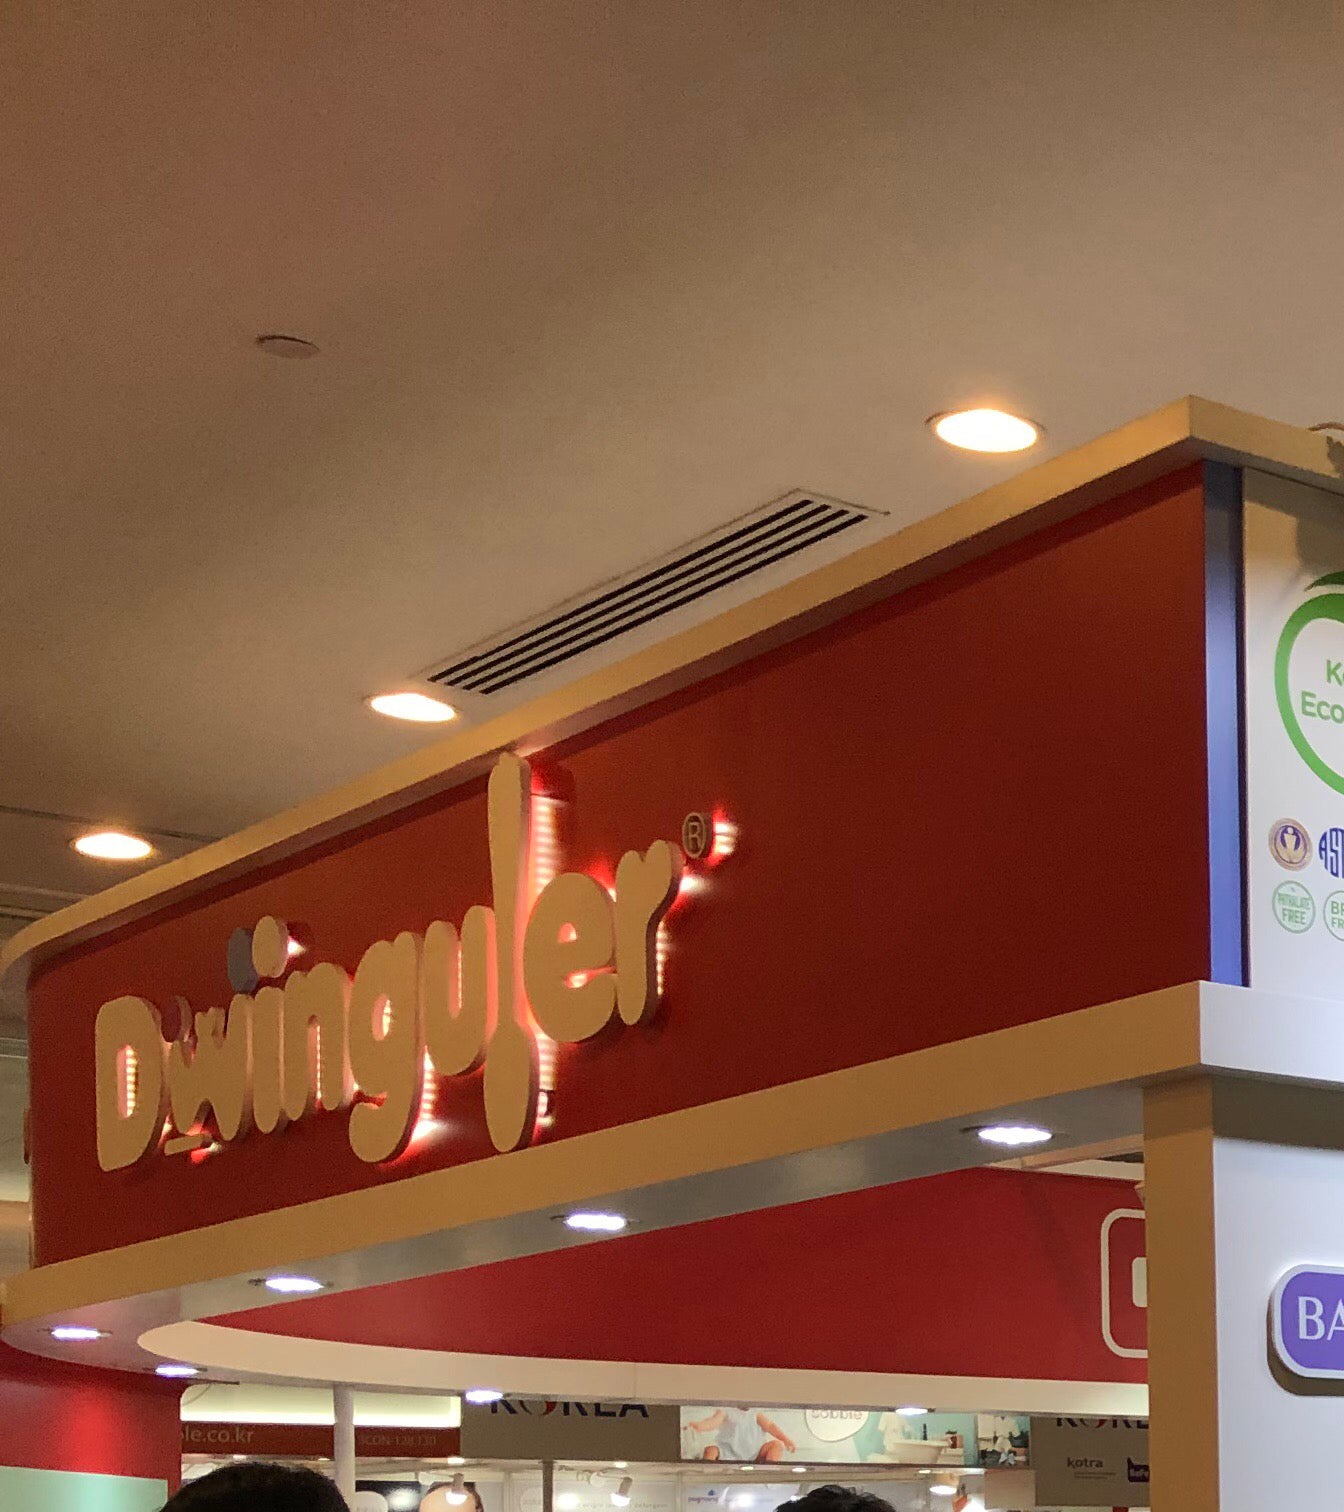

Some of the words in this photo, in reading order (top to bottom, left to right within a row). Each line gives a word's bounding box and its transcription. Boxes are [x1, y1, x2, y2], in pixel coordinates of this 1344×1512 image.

[1282, 909, 1307, 926] FREE
[95, 752, 684, 1171] Dwinguler
[1067, 1457, 1104, 1470] kotra
